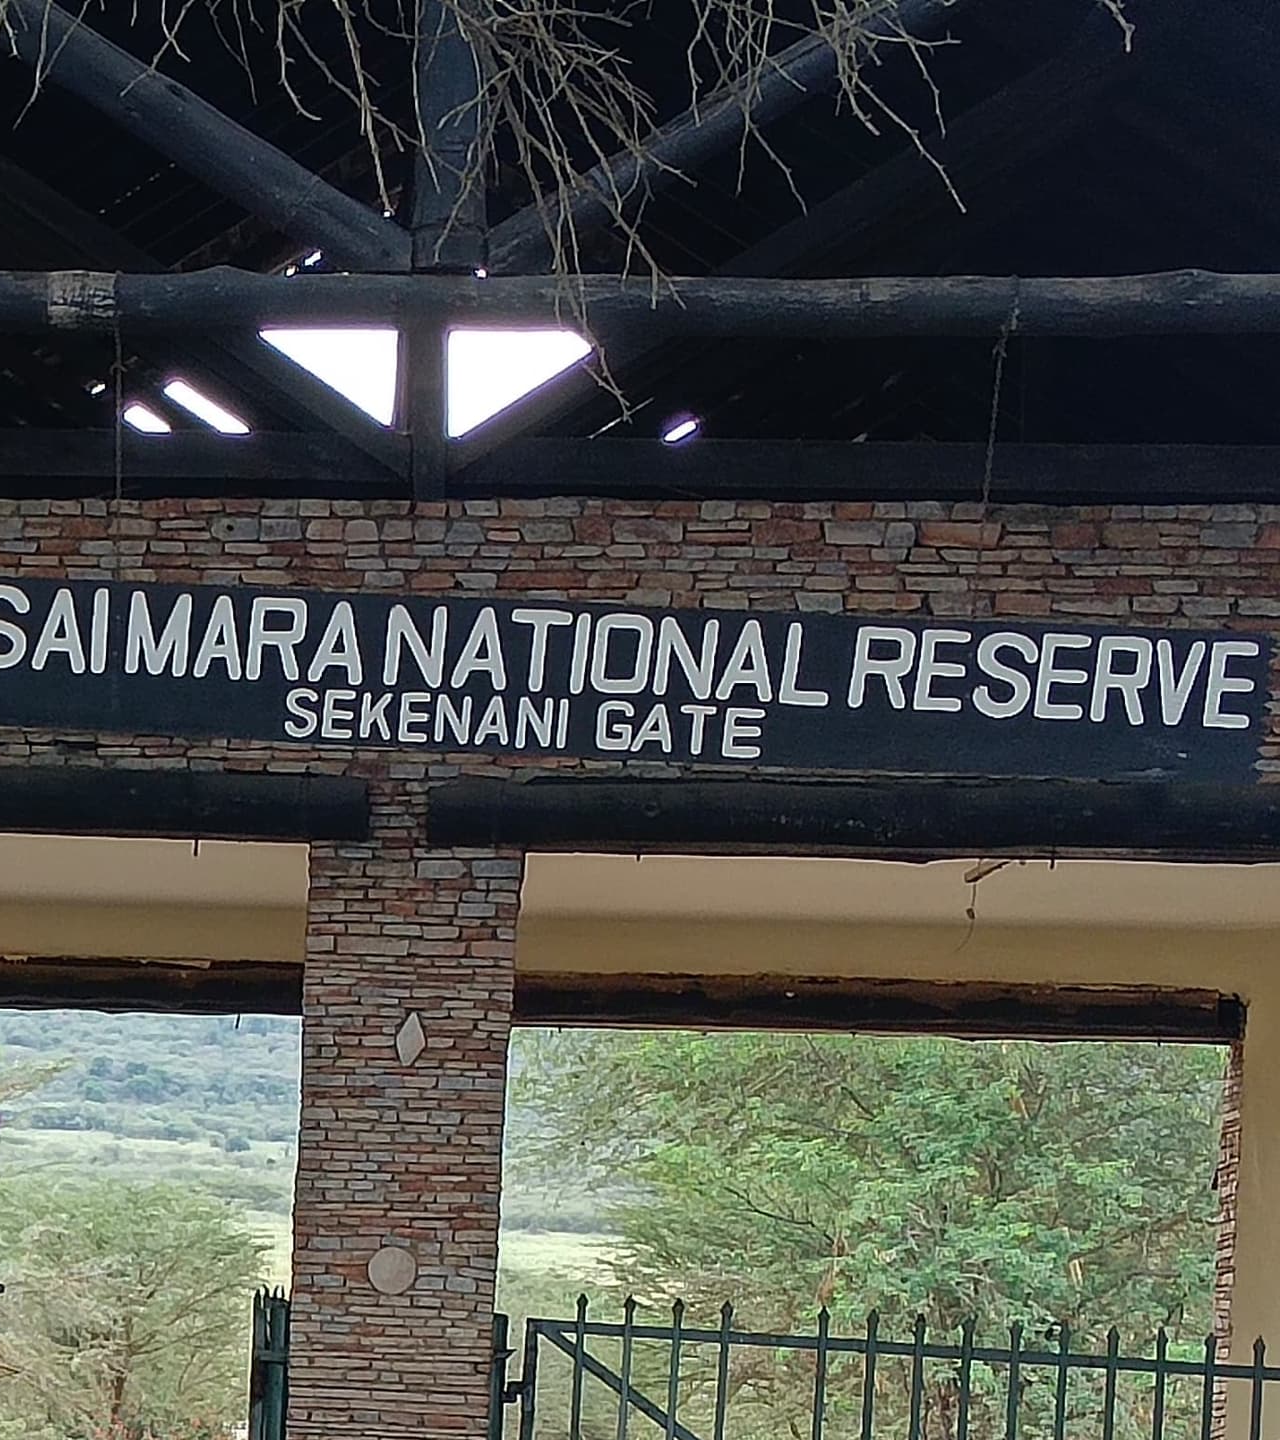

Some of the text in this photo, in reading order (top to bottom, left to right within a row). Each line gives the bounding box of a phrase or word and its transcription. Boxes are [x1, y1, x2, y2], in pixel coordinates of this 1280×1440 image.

[125, 590, 362, 686] MARA
[383, 604, 829, 706] NATIONAL
[847, 625, 1259, 729] RESERVE
[284, 687, 766, 759] SEKENANI GATE
